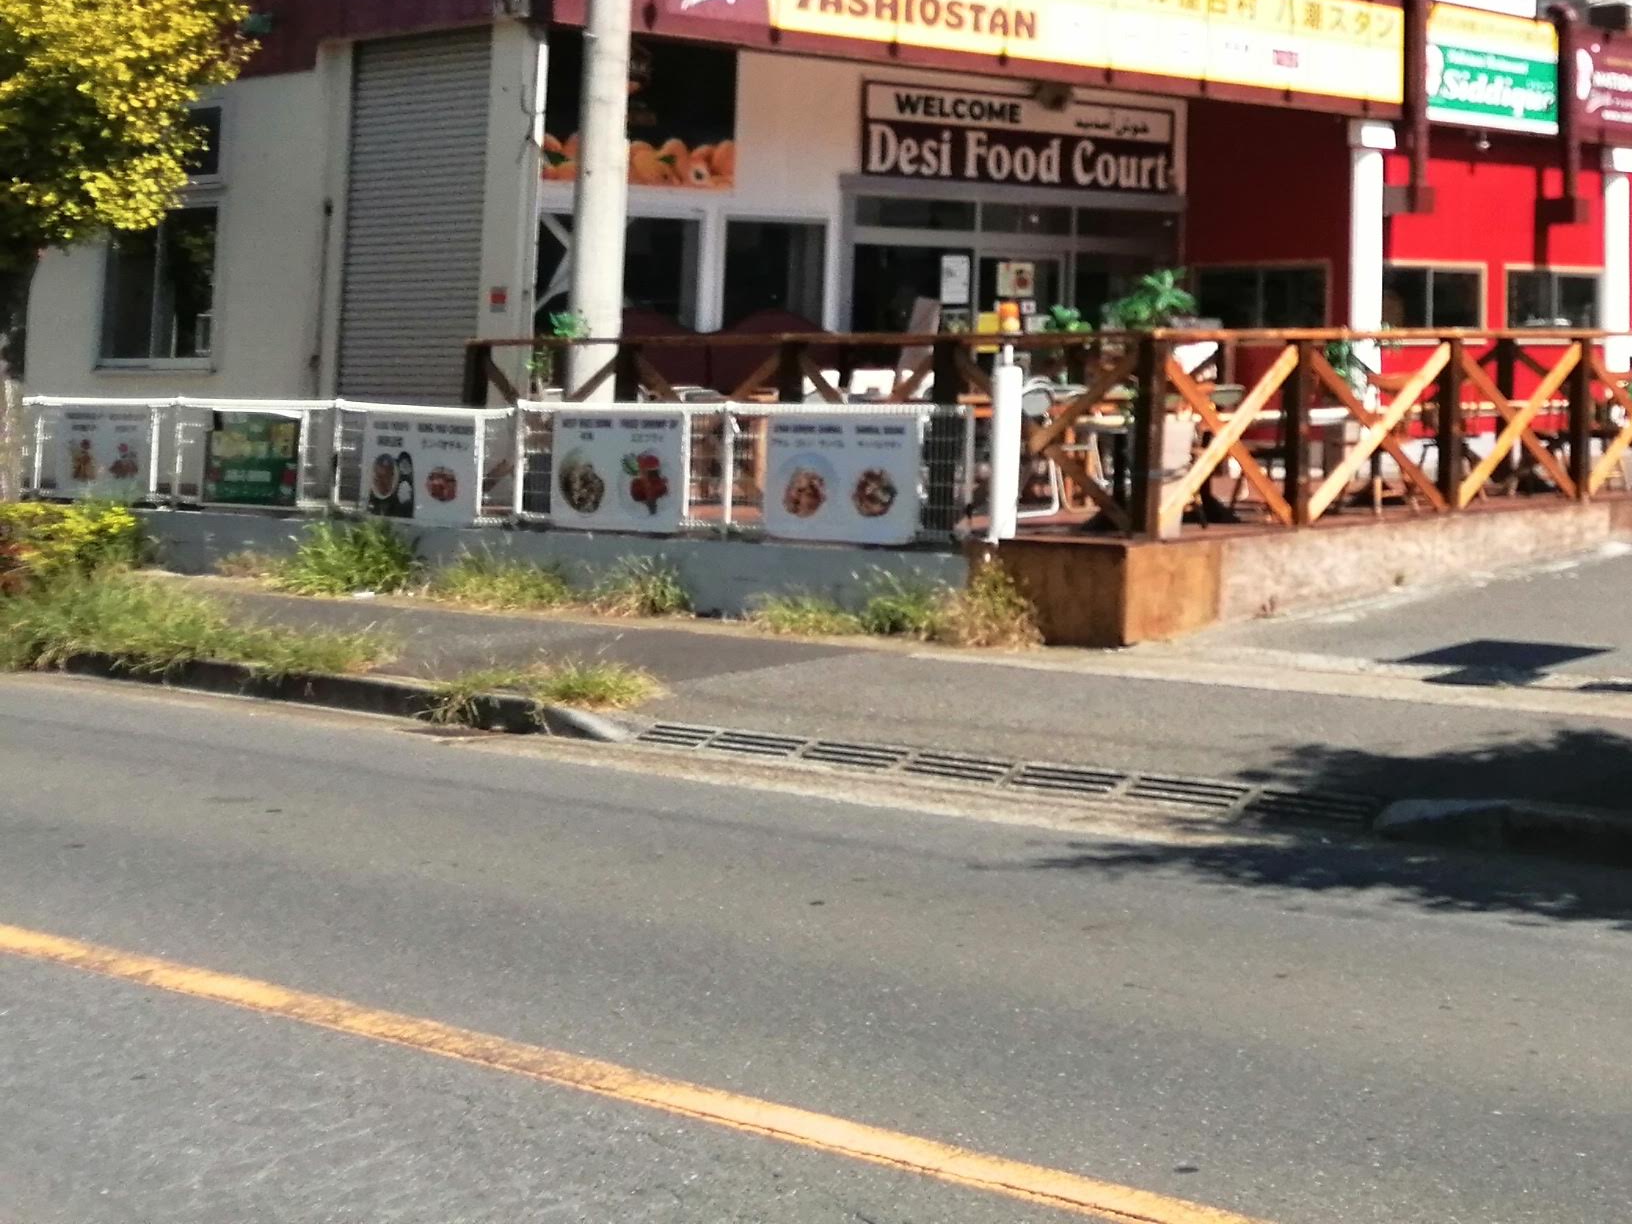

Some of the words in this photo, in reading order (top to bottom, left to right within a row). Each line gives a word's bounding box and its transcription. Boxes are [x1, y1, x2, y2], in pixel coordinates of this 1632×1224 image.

[895, 92, 1022, 124] WELCOME
[867, 122, 952, 177] Desi
[964, 130, 1061, 185] Food
[1072, 140, 1169, 192] Court
